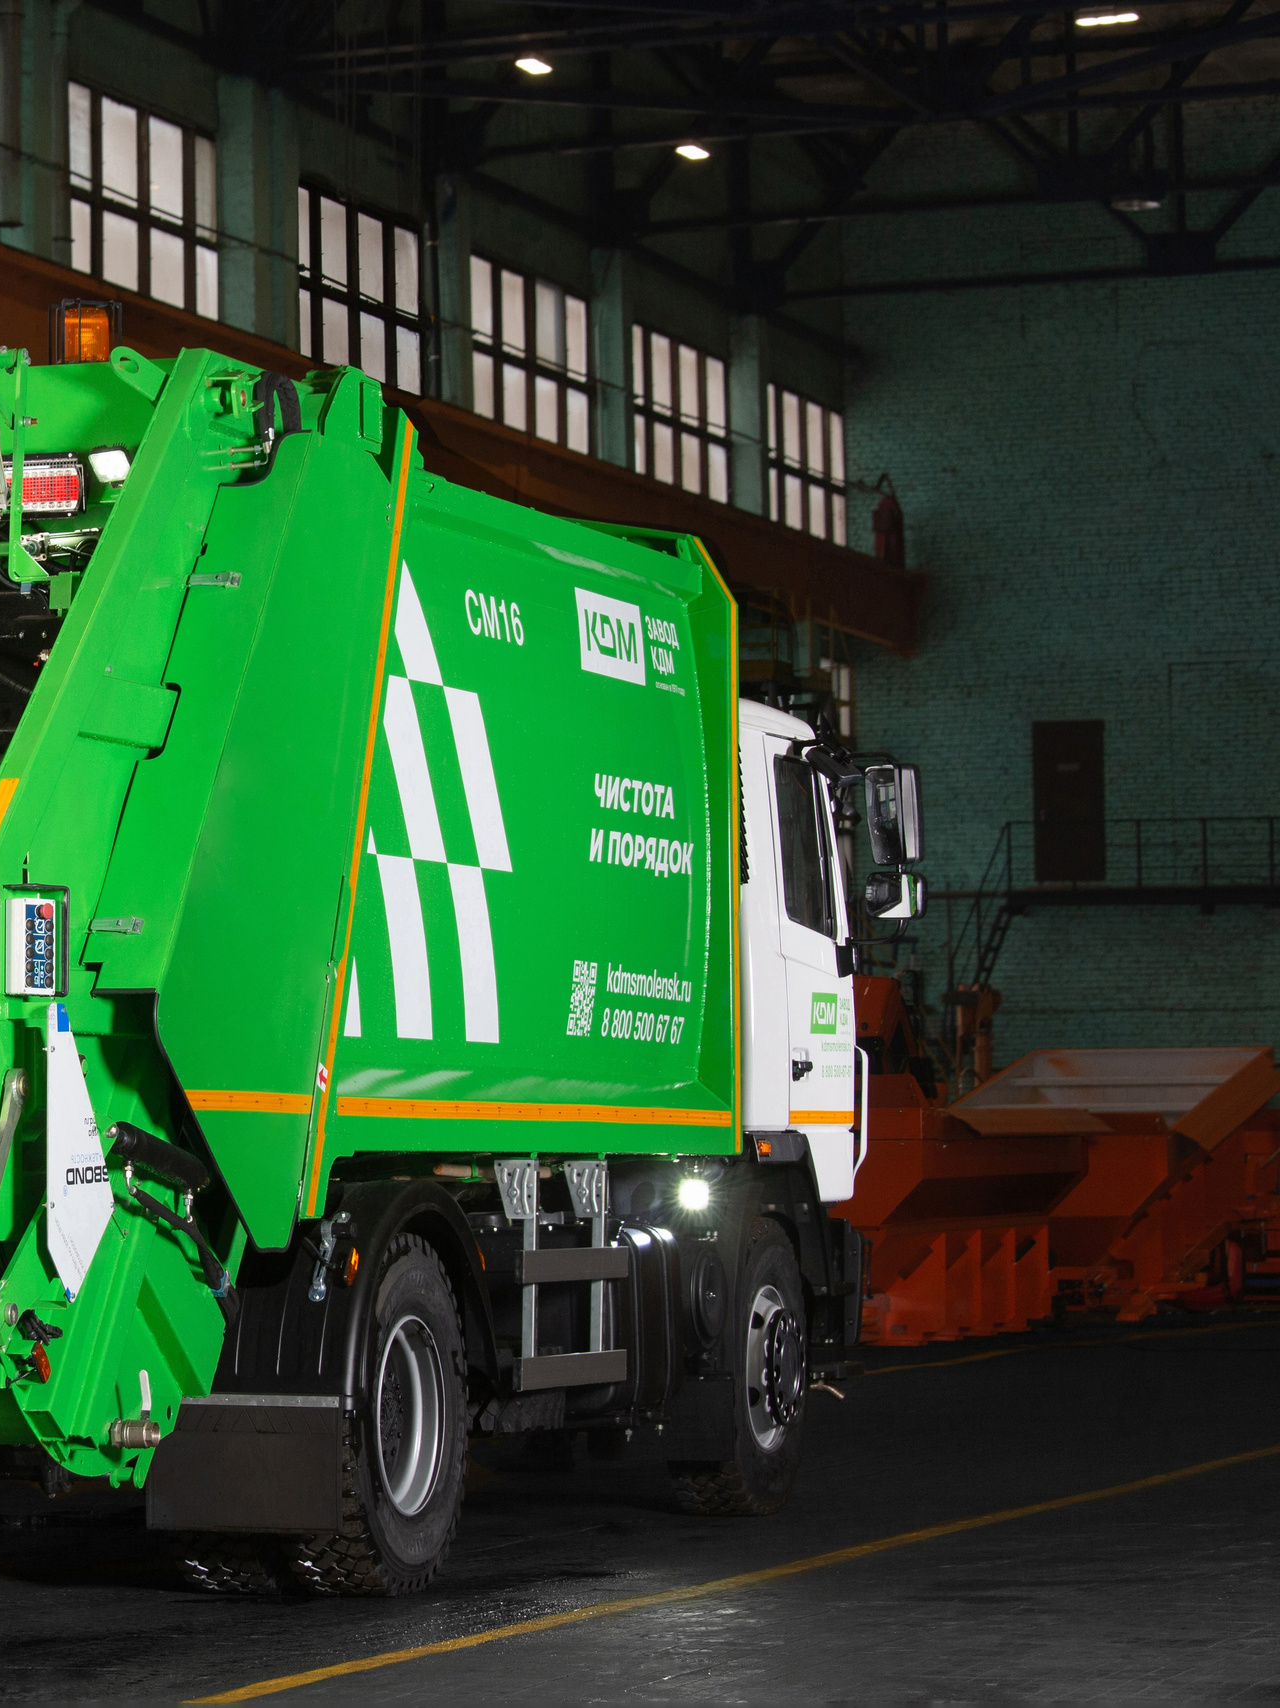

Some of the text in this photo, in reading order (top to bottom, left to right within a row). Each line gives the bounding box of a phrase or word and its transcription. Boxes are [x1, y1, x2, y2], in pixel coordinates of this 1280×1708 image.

[583, 608, 638, 664] KDM
[645, 615, 680, 651] ЗАВОД
[650, 645, 675, 676] КДМ
[594, 773, 675, 820] ЧИСТОТА
[589, 828, 694, 878] И ПОРЯДОК
[606, 962, 692, 1003] kdmsmolensk.ru
[601, 1007, 685, 1045] 8 800 500 67 67
[813, 1002, 836, 1025] KDM
